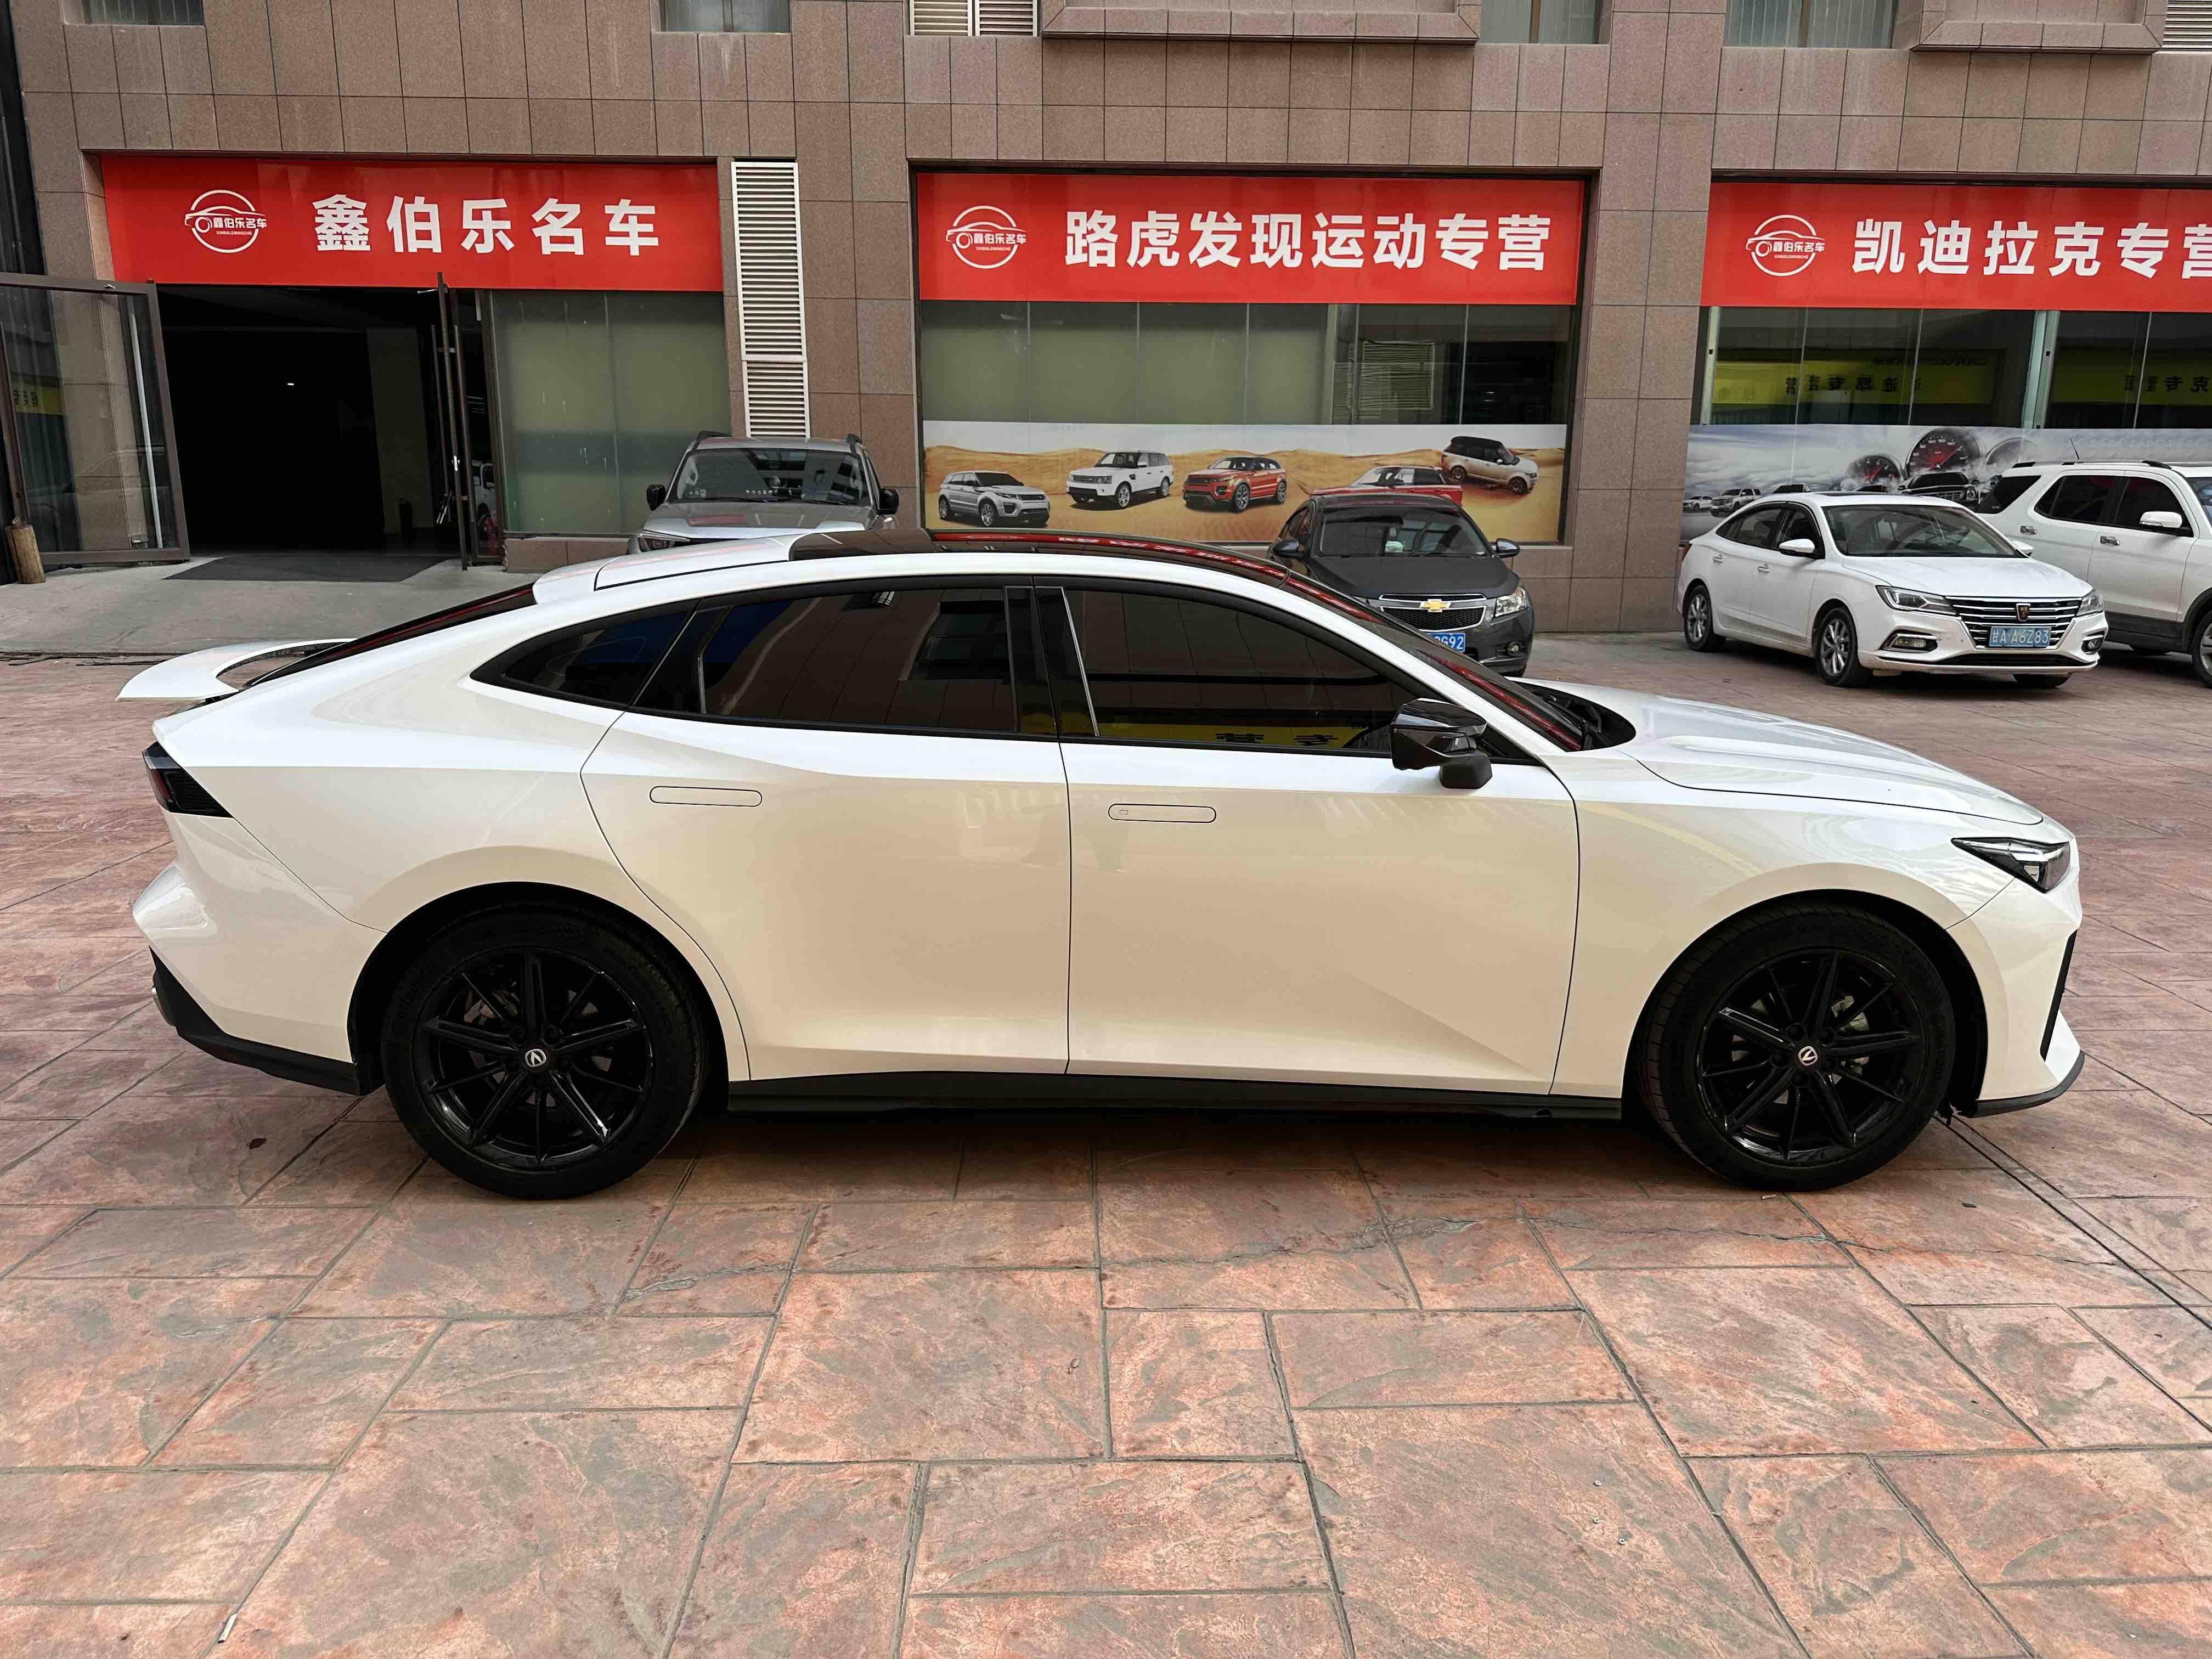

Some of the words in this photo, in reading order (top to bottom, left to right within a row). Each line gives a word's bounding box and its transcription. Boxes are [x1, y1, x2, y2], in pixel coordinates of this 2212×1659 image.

[313, 195, 658, 256] 鑫伯乐名车
[1065, 210, 1550, 270] 路虎发现运动专营
[1852, 219, 2212, 279] 凯迪拉克专营
